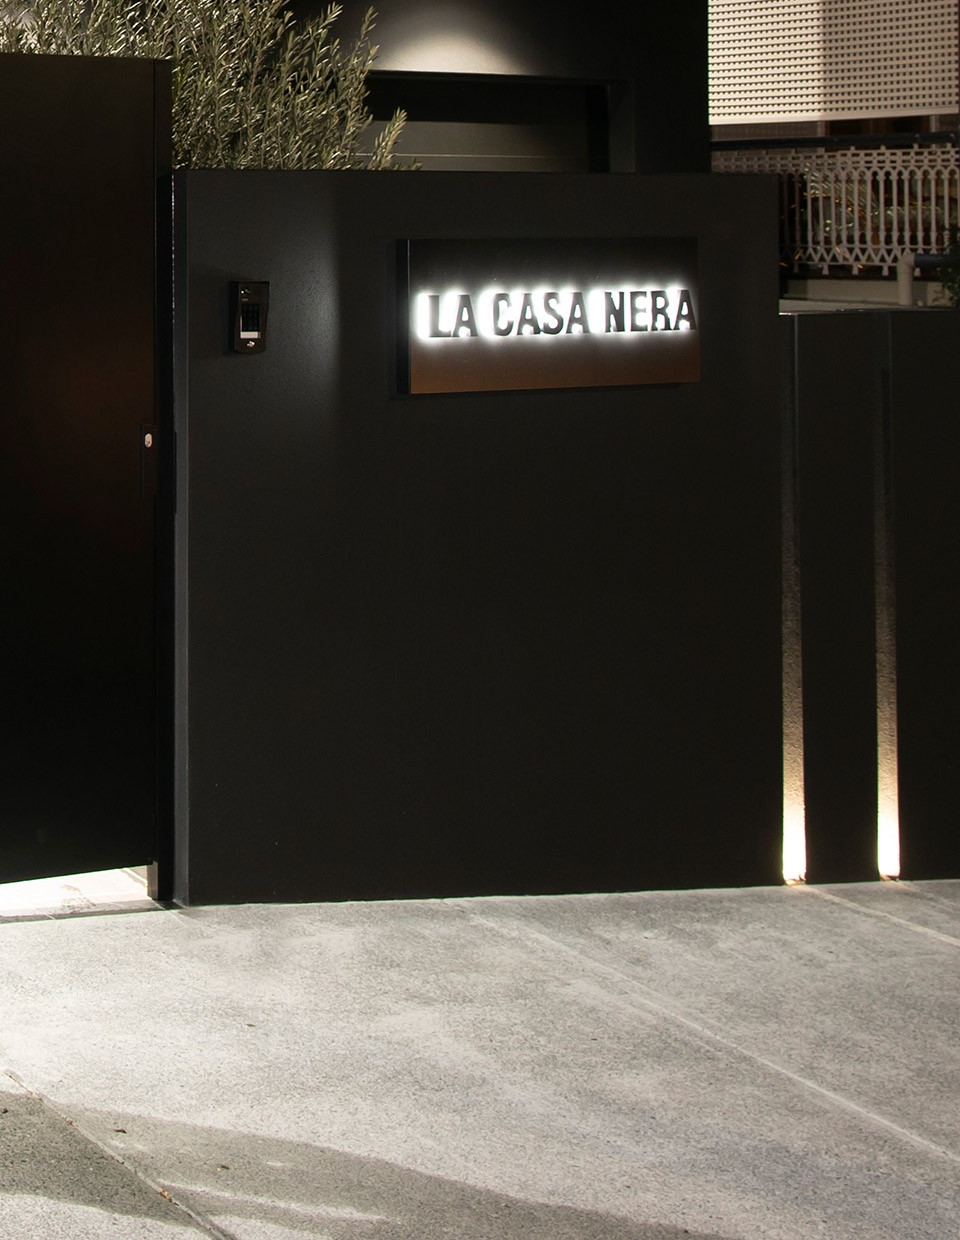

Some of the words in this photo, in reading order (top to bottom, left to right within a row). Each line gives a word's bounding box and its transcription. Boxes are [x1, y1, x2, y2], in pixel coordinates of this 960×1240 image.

[428, 294, 478, 337] LA
[492, 291, 589, 337] CASA
[604, 289, 697, 333] NERA
